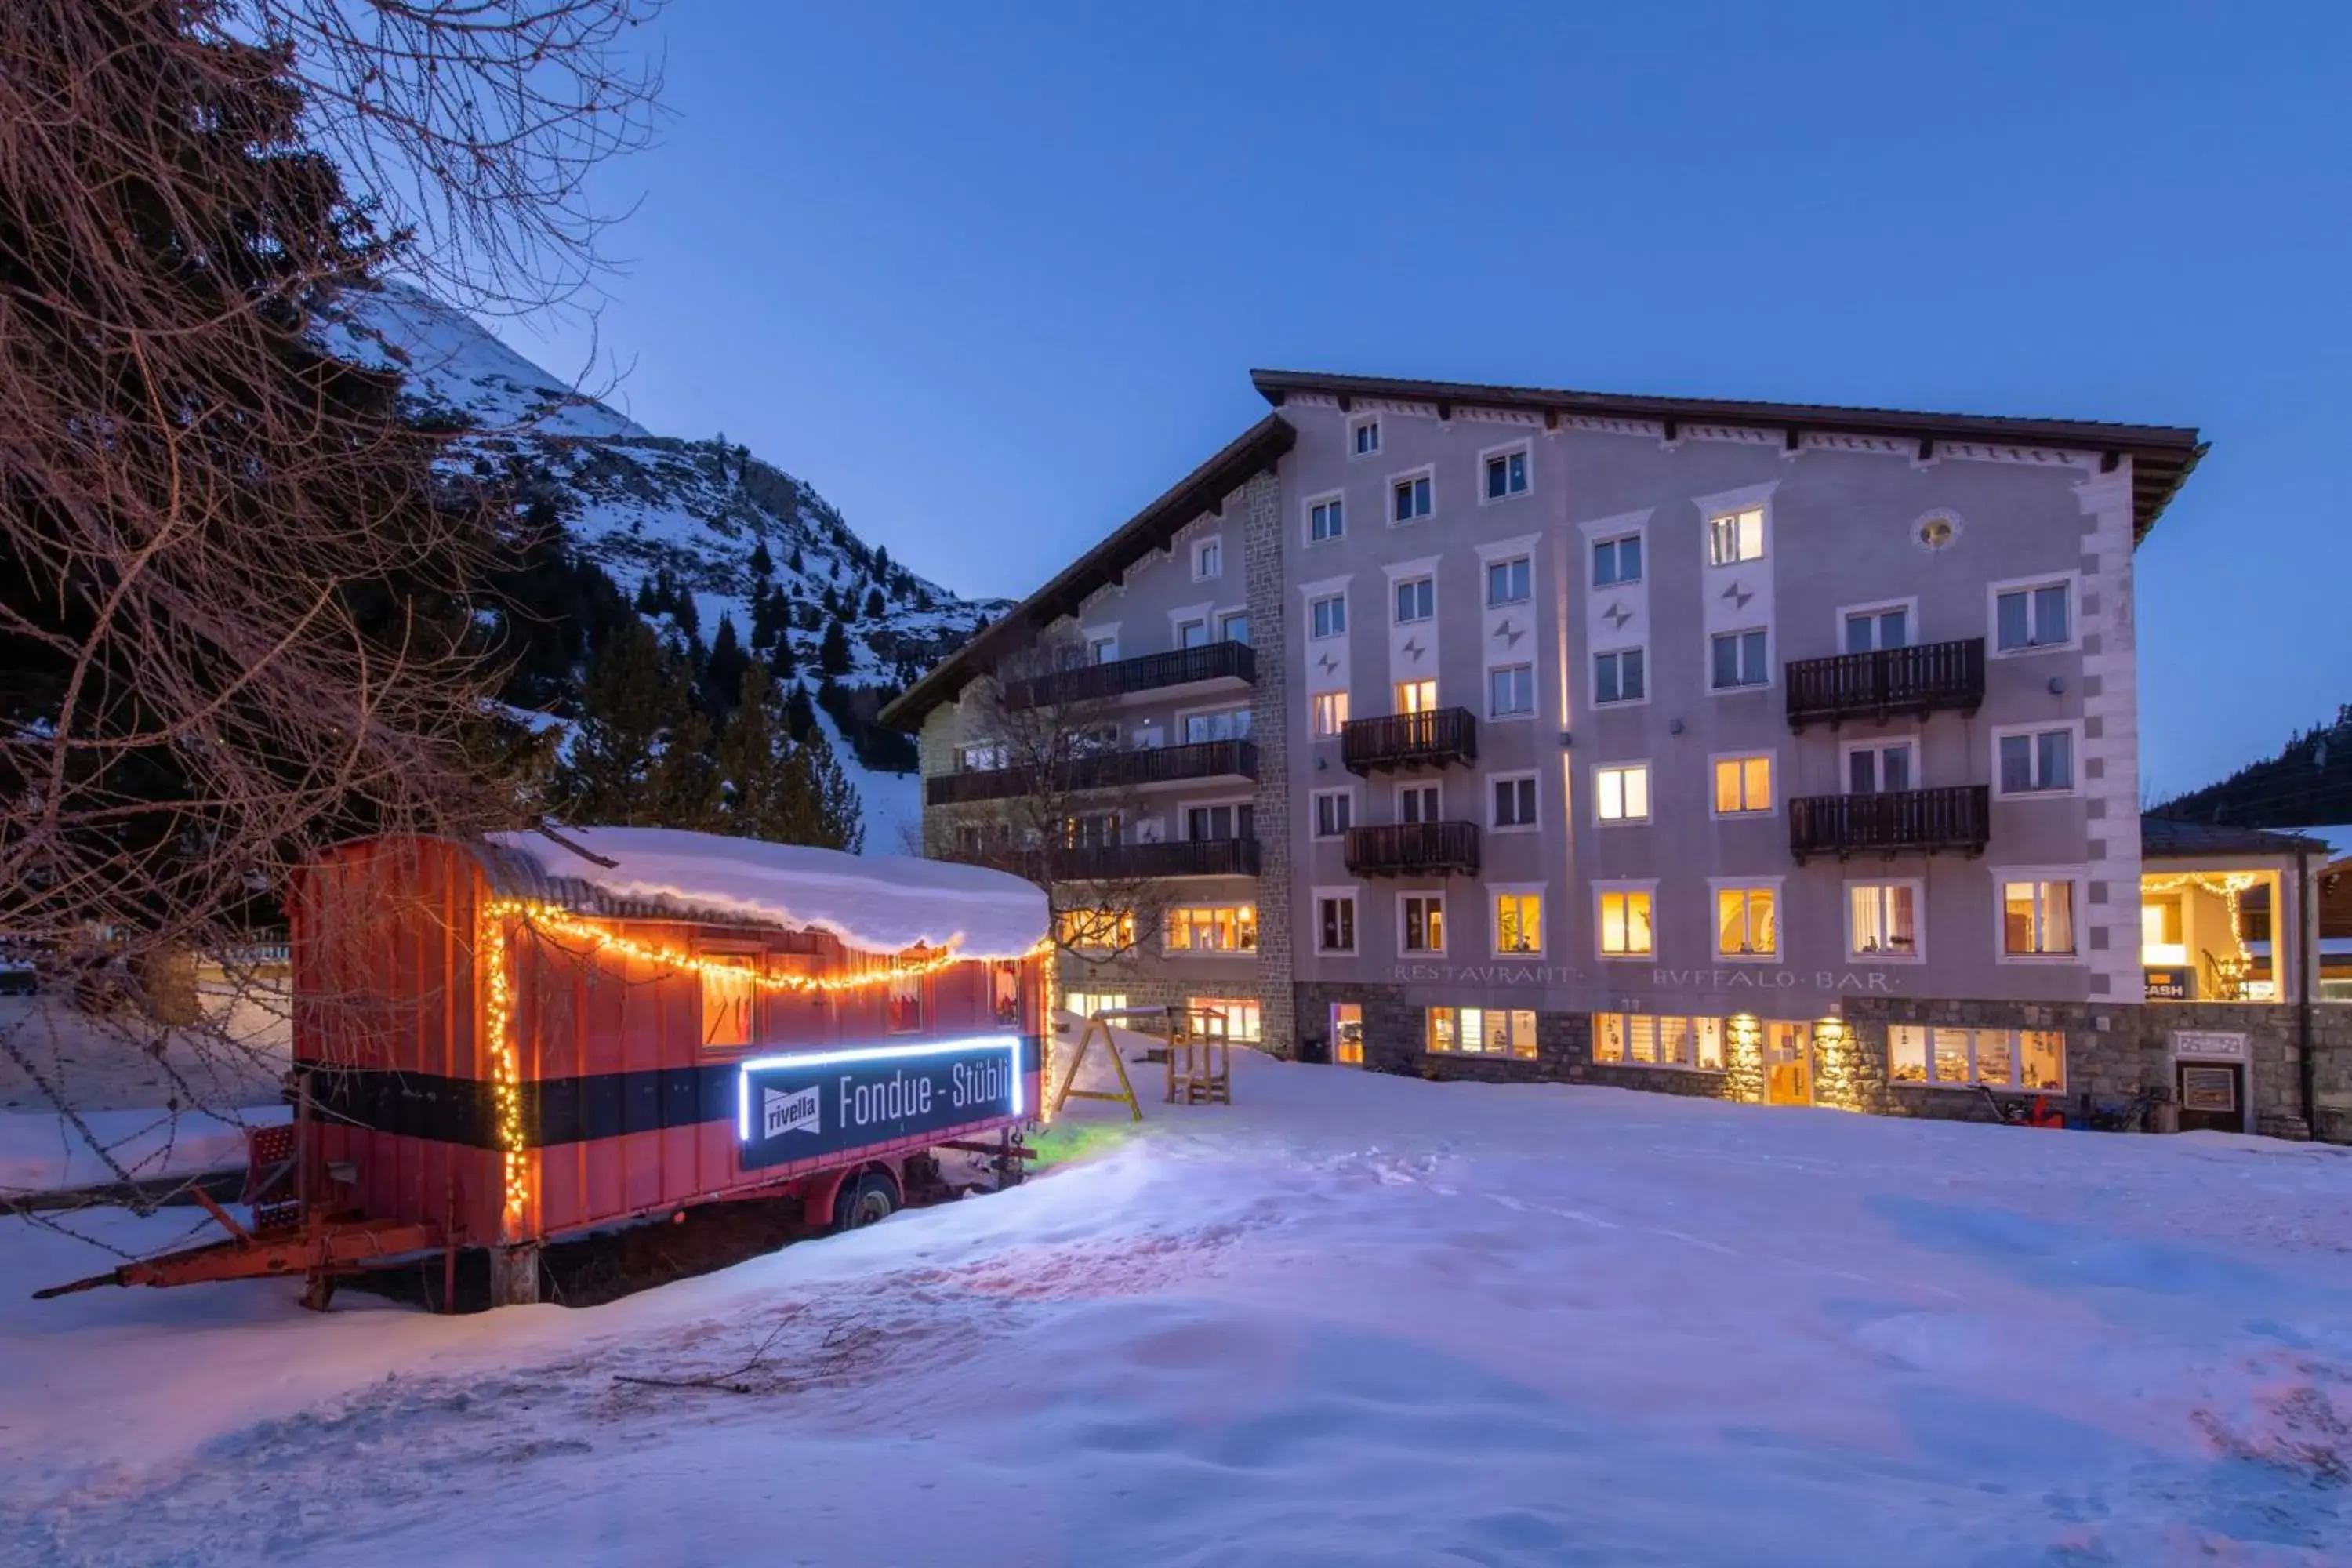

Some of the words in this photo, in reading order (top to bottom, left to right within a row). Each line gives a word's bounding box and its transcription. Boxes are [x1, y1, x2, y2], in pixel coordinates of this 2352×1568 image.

[1816, 971, 1893, 993] BAR
[840, 1069, 931, 1128] Fondue
[953, 1057, 1009, 1107] Stübli
[768, 1096, 815, 1131] rivella
